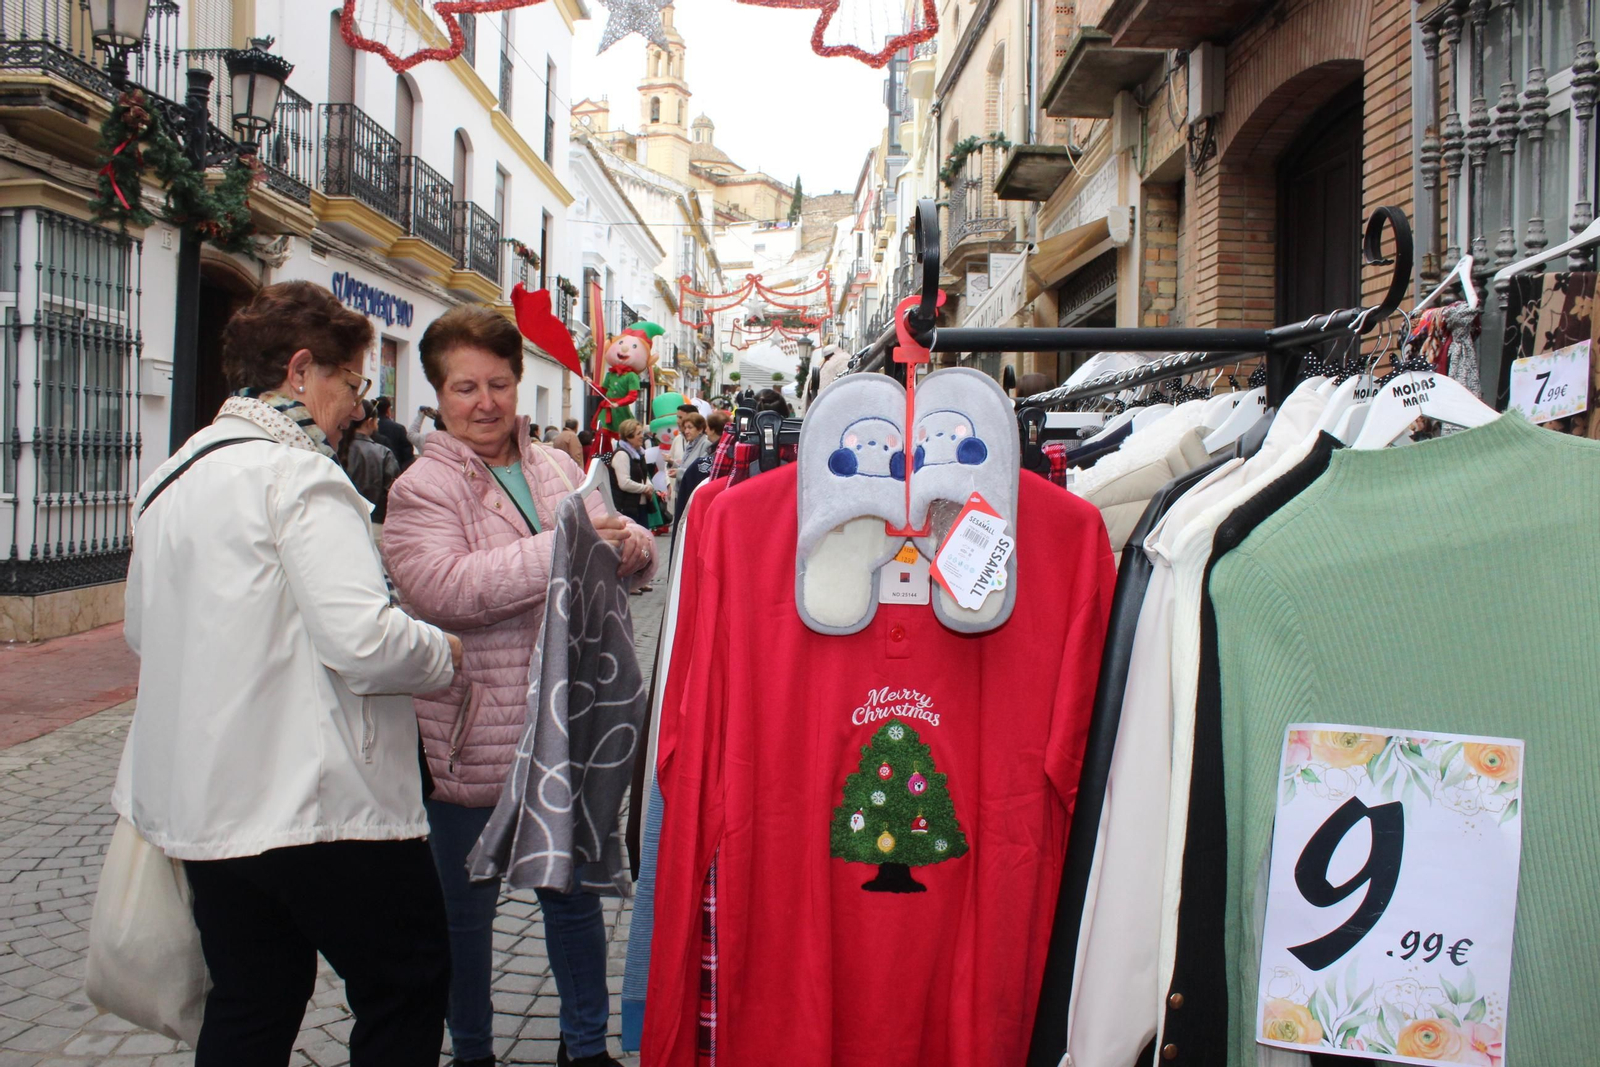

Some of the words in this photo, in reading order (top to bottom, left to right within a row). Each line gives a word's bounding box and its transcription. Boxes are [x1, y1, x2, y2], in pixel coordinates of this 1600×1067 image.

[332, 271, 414, 328] SUPERMERCADO
[1392, 377, 1436, 398] MODAS
[1534, 370, 1568, 405] 7.99€
[1402, 392, 1430, 408] MARI
[969, 515, 995, 536] SESAMALL
[969, 538, 1010, 597] SESAMALL
[863, 686, 934, 708] Merry
[851, 702, 940, 727] Christmas
